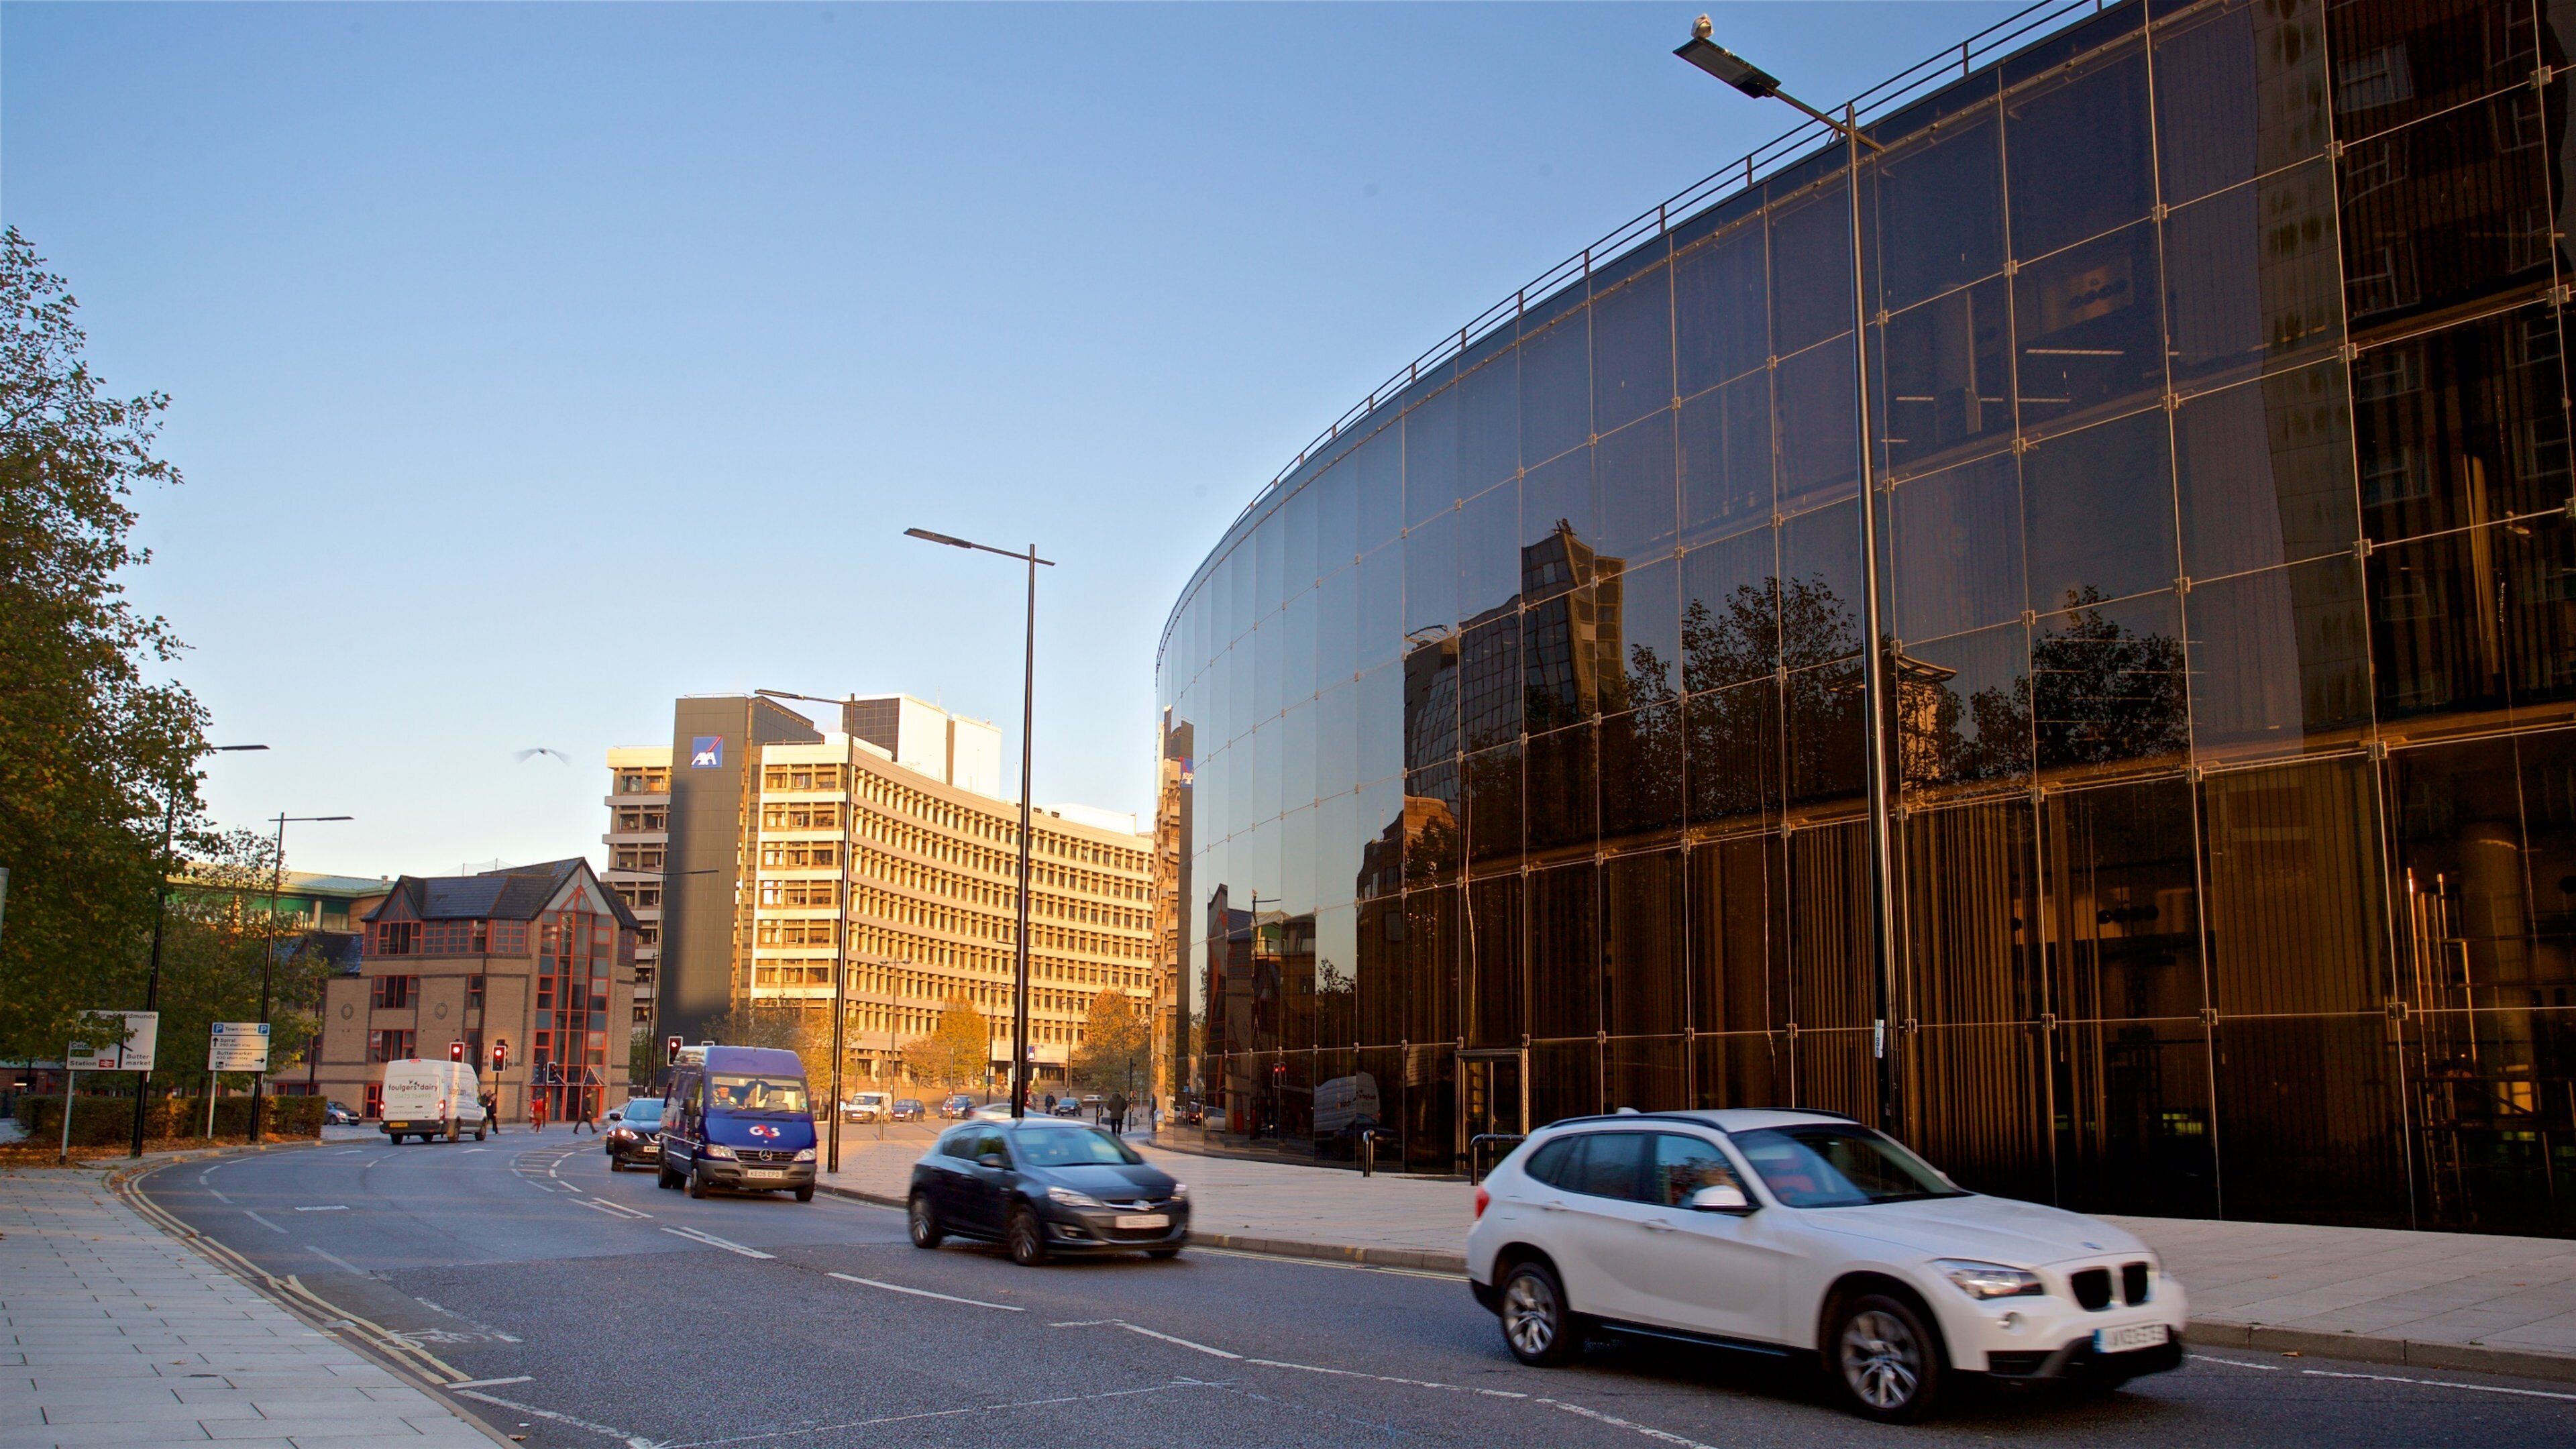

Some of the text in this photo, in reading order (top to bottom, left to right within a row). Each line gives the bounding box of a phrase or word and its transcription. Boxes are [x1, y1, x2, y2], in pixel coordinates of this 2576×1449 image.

[691, 751, 717, 765] AXA
[388, 1083, 417, 1092] foulgers
[420, 1083, 438, 1092] dairy
[749, 1124, 781, 1138] G4S
